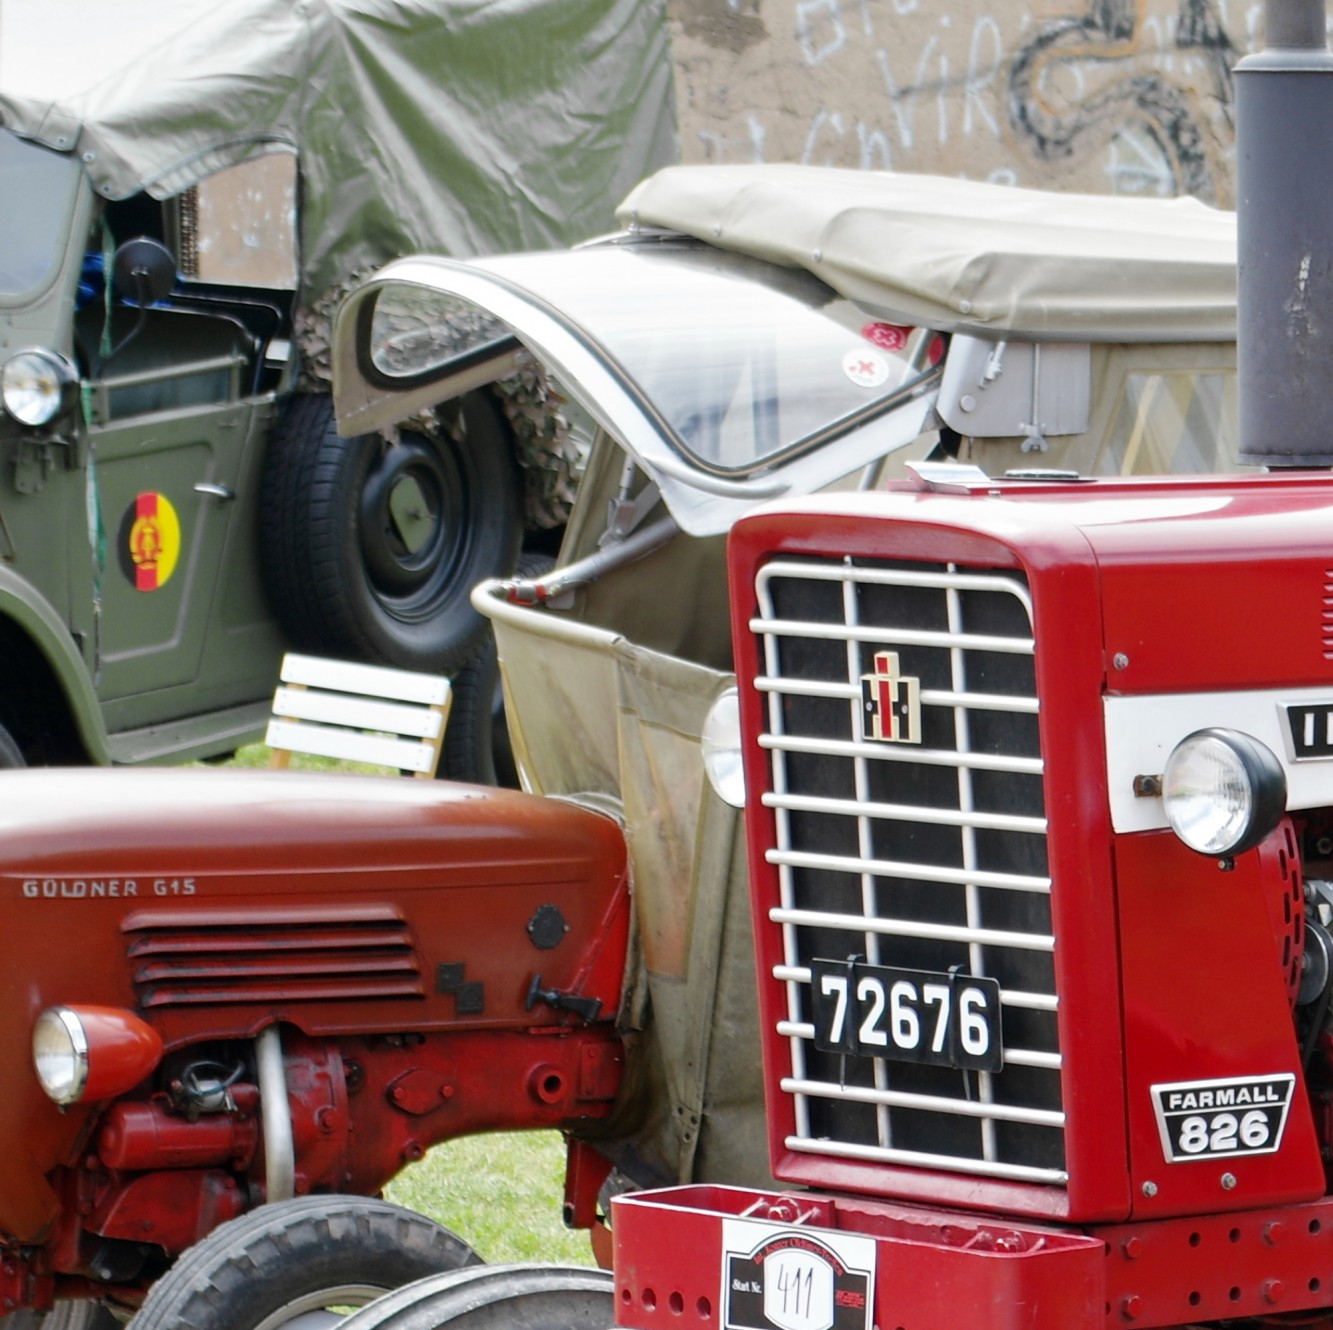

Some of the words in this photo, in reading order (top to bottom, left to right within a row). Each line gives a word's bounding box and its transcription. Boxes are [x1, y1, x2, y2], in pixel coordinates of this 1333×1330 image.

[22, 880, 138, 898] GÜLDNER
[153, 879, 196, 896] G15
[820, 974, 990, 1057] 72676
[1169, 1085, 1280, 1111] FARMALL
[1178, 1110, 1270, 1154] 826
[732, 1278, 751, 1293] Start
[751, 1280, 762, 1294] Nr.
[777, 1263, 814, 1319] 411
